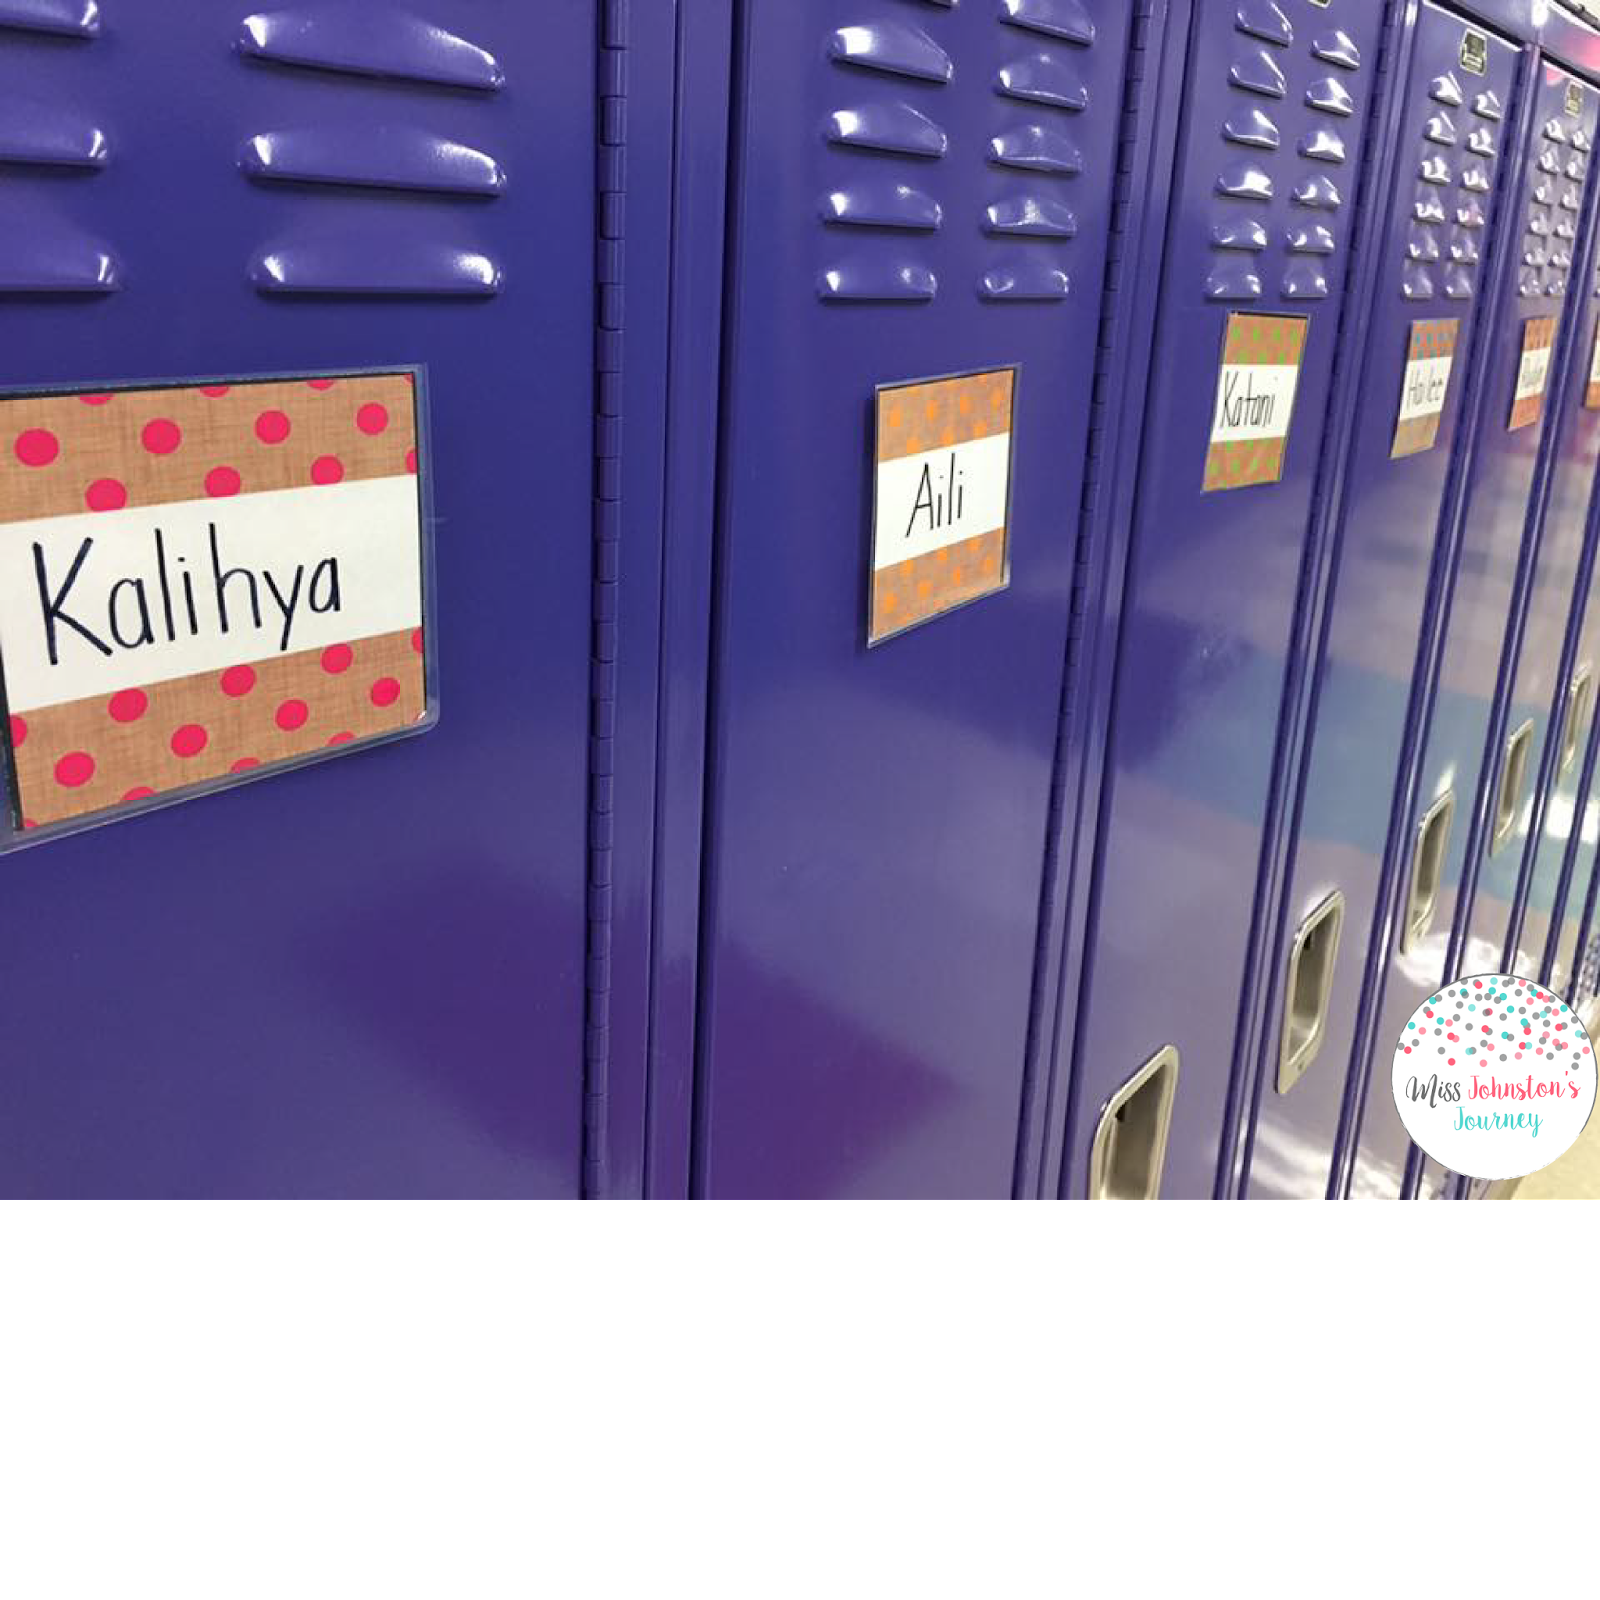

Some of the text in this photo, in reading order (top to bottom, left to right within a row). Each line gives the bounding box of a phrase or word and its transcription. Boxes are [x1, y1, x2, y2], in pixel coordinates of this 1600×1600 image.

[1220, 370, 1278, 428] Katani
[904, 452, 964, 538] Aili
[32, 522, 341, 666] Kalihya
